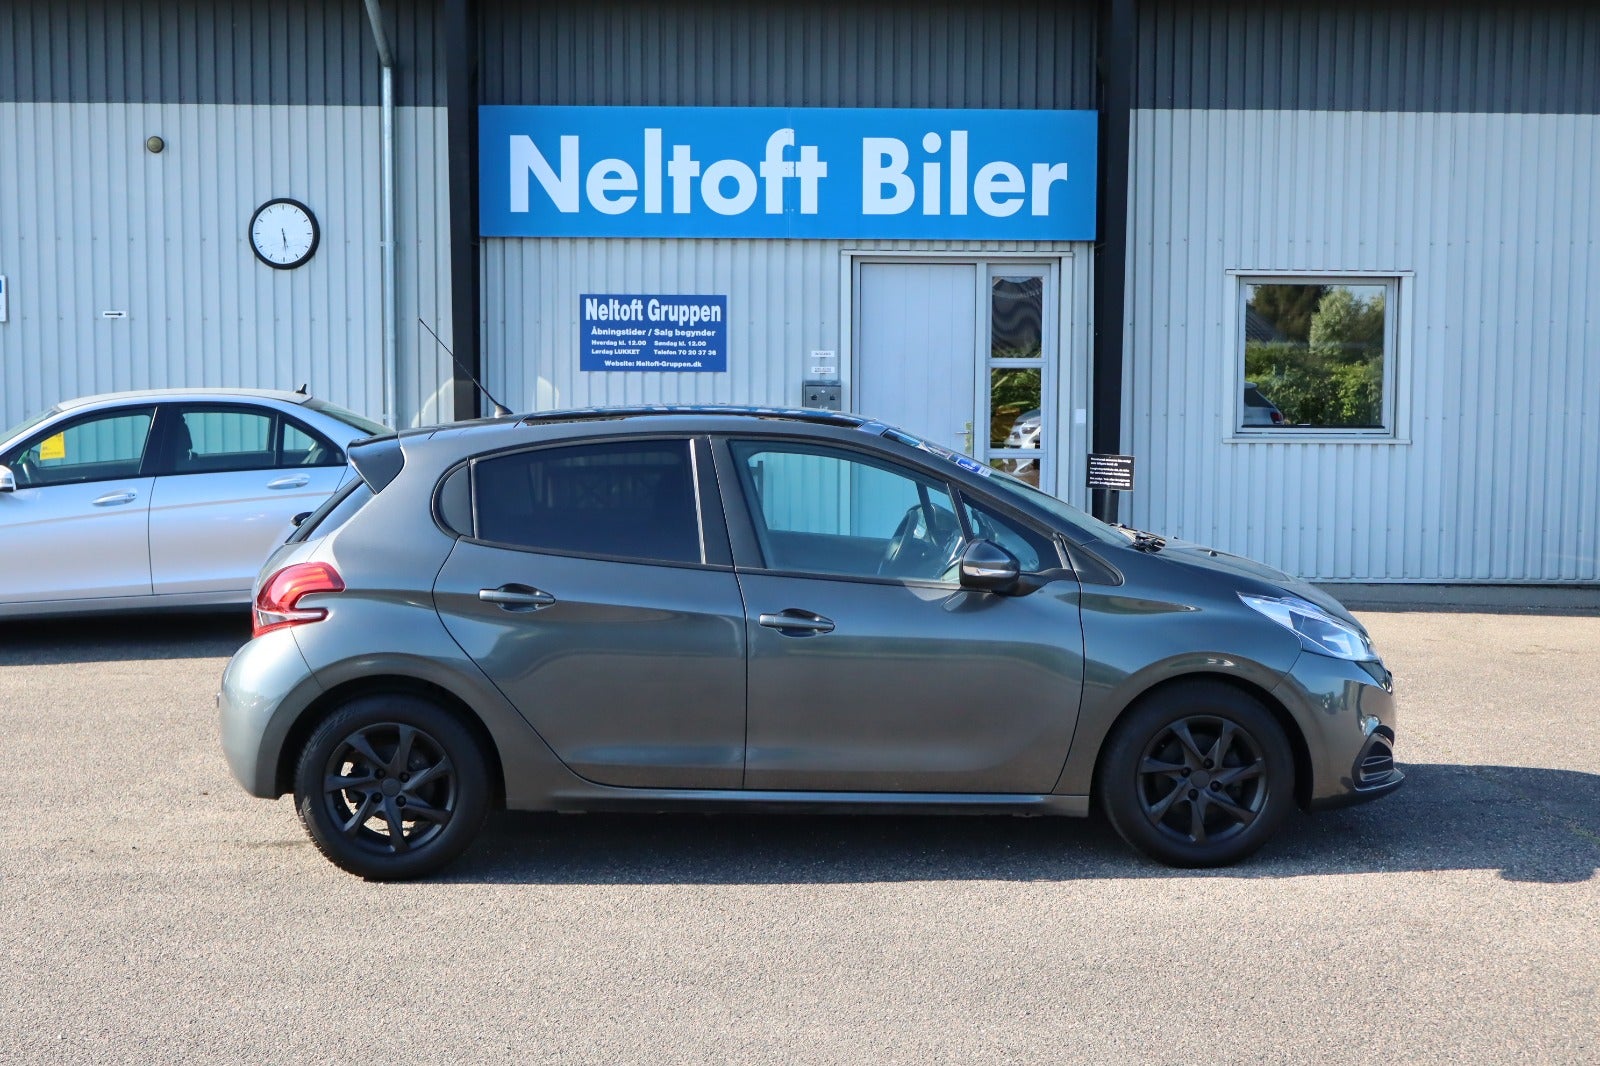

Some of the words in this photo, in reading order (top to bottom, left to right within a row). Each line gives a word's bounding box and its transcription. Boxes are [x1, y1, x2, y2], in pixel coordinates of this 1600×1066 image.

[510, 128, 827, 216] Neltoft
[862, 130, 1068, 217] Biler
[585, 298, 643, 321] Neltoft
[648, 299, 721, 326] Gruppen
[591, 326, 647, 336] Åbningstider
[654, 329, 673, 337] Salg
[675, 329, 716, 337] begynder
